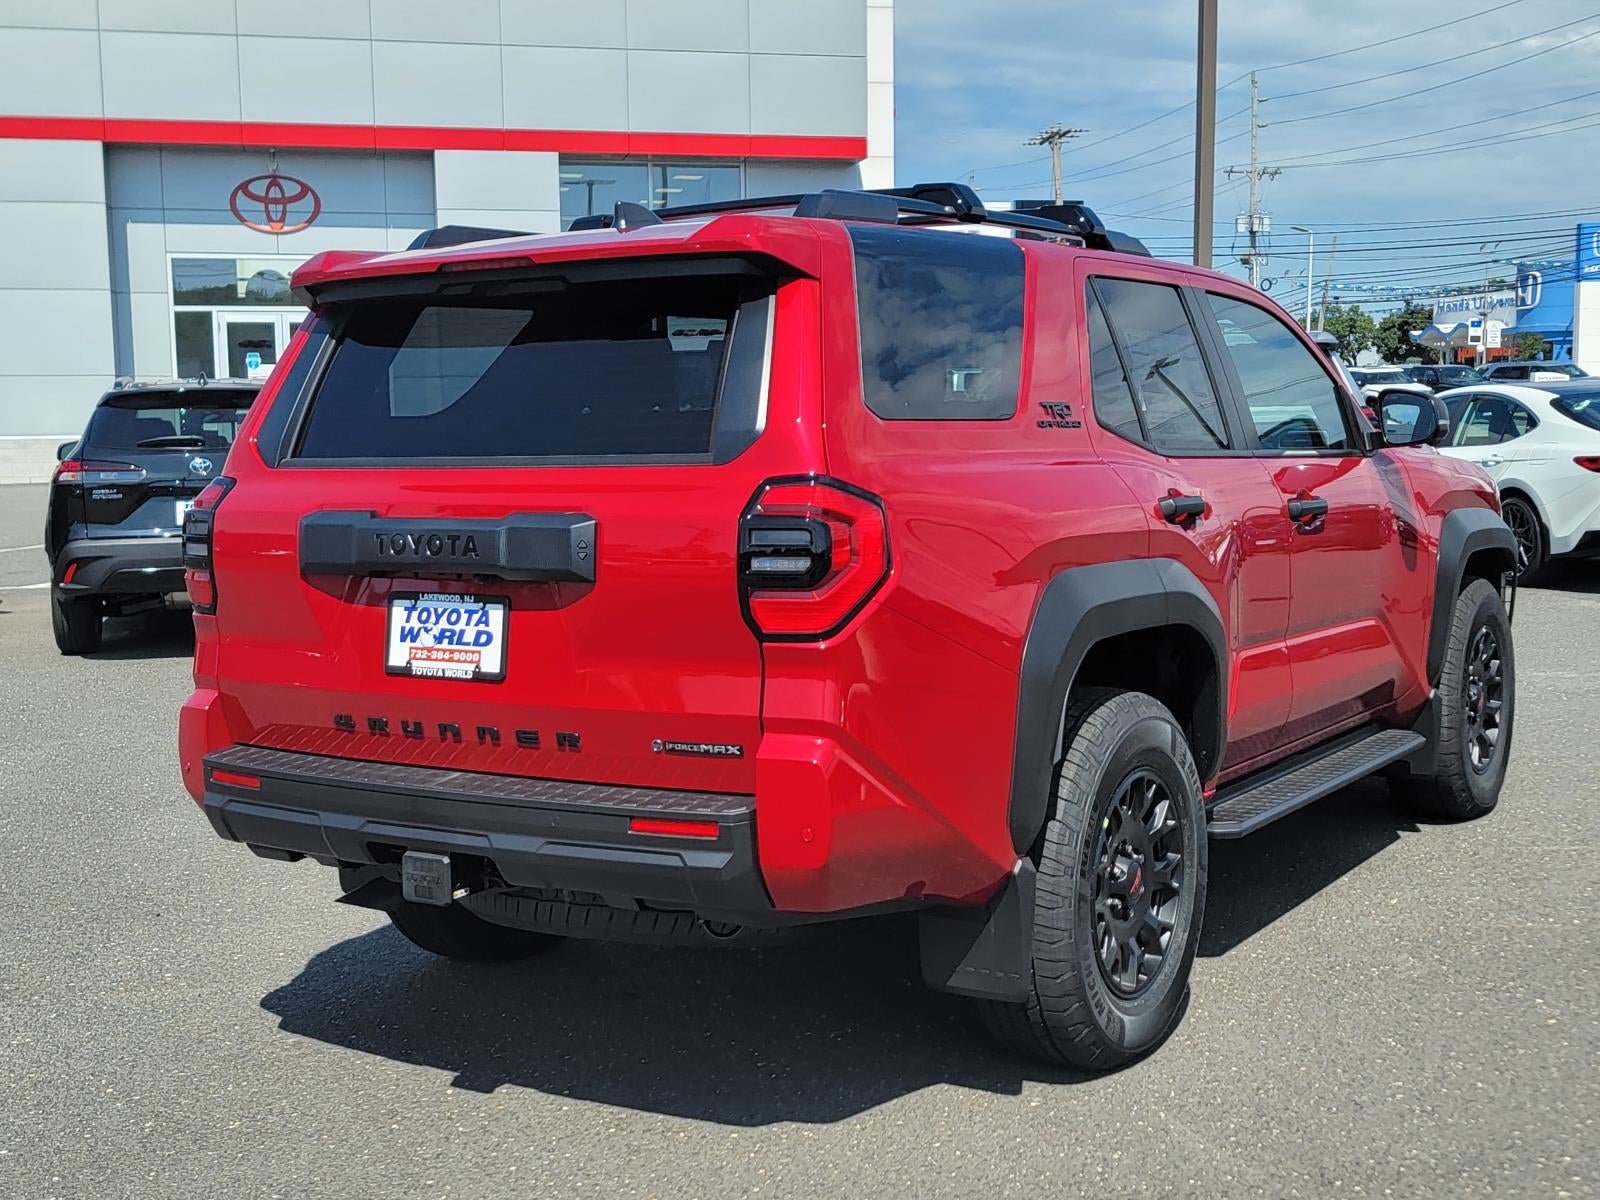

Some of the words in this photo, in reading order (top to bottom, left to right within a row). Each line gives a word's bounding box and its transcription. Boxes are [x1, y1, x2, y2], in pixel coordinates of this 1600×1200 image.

[1437, 298, 1470, 313] Honda
[1039, 401, 1073, 420] TRD
[375, 533, 480, 558] TOYOTA
[419, 593, 462, 604] LAKEWOOD,
[464, 595, 475, 603] NJ
[403, 606, 490, 627] TOYOTA
[412, 667, 443, 677] TOYOTA
[445, 669, 473, 679] WORLD
[334, 713, 582, 753] 4RUNNER
